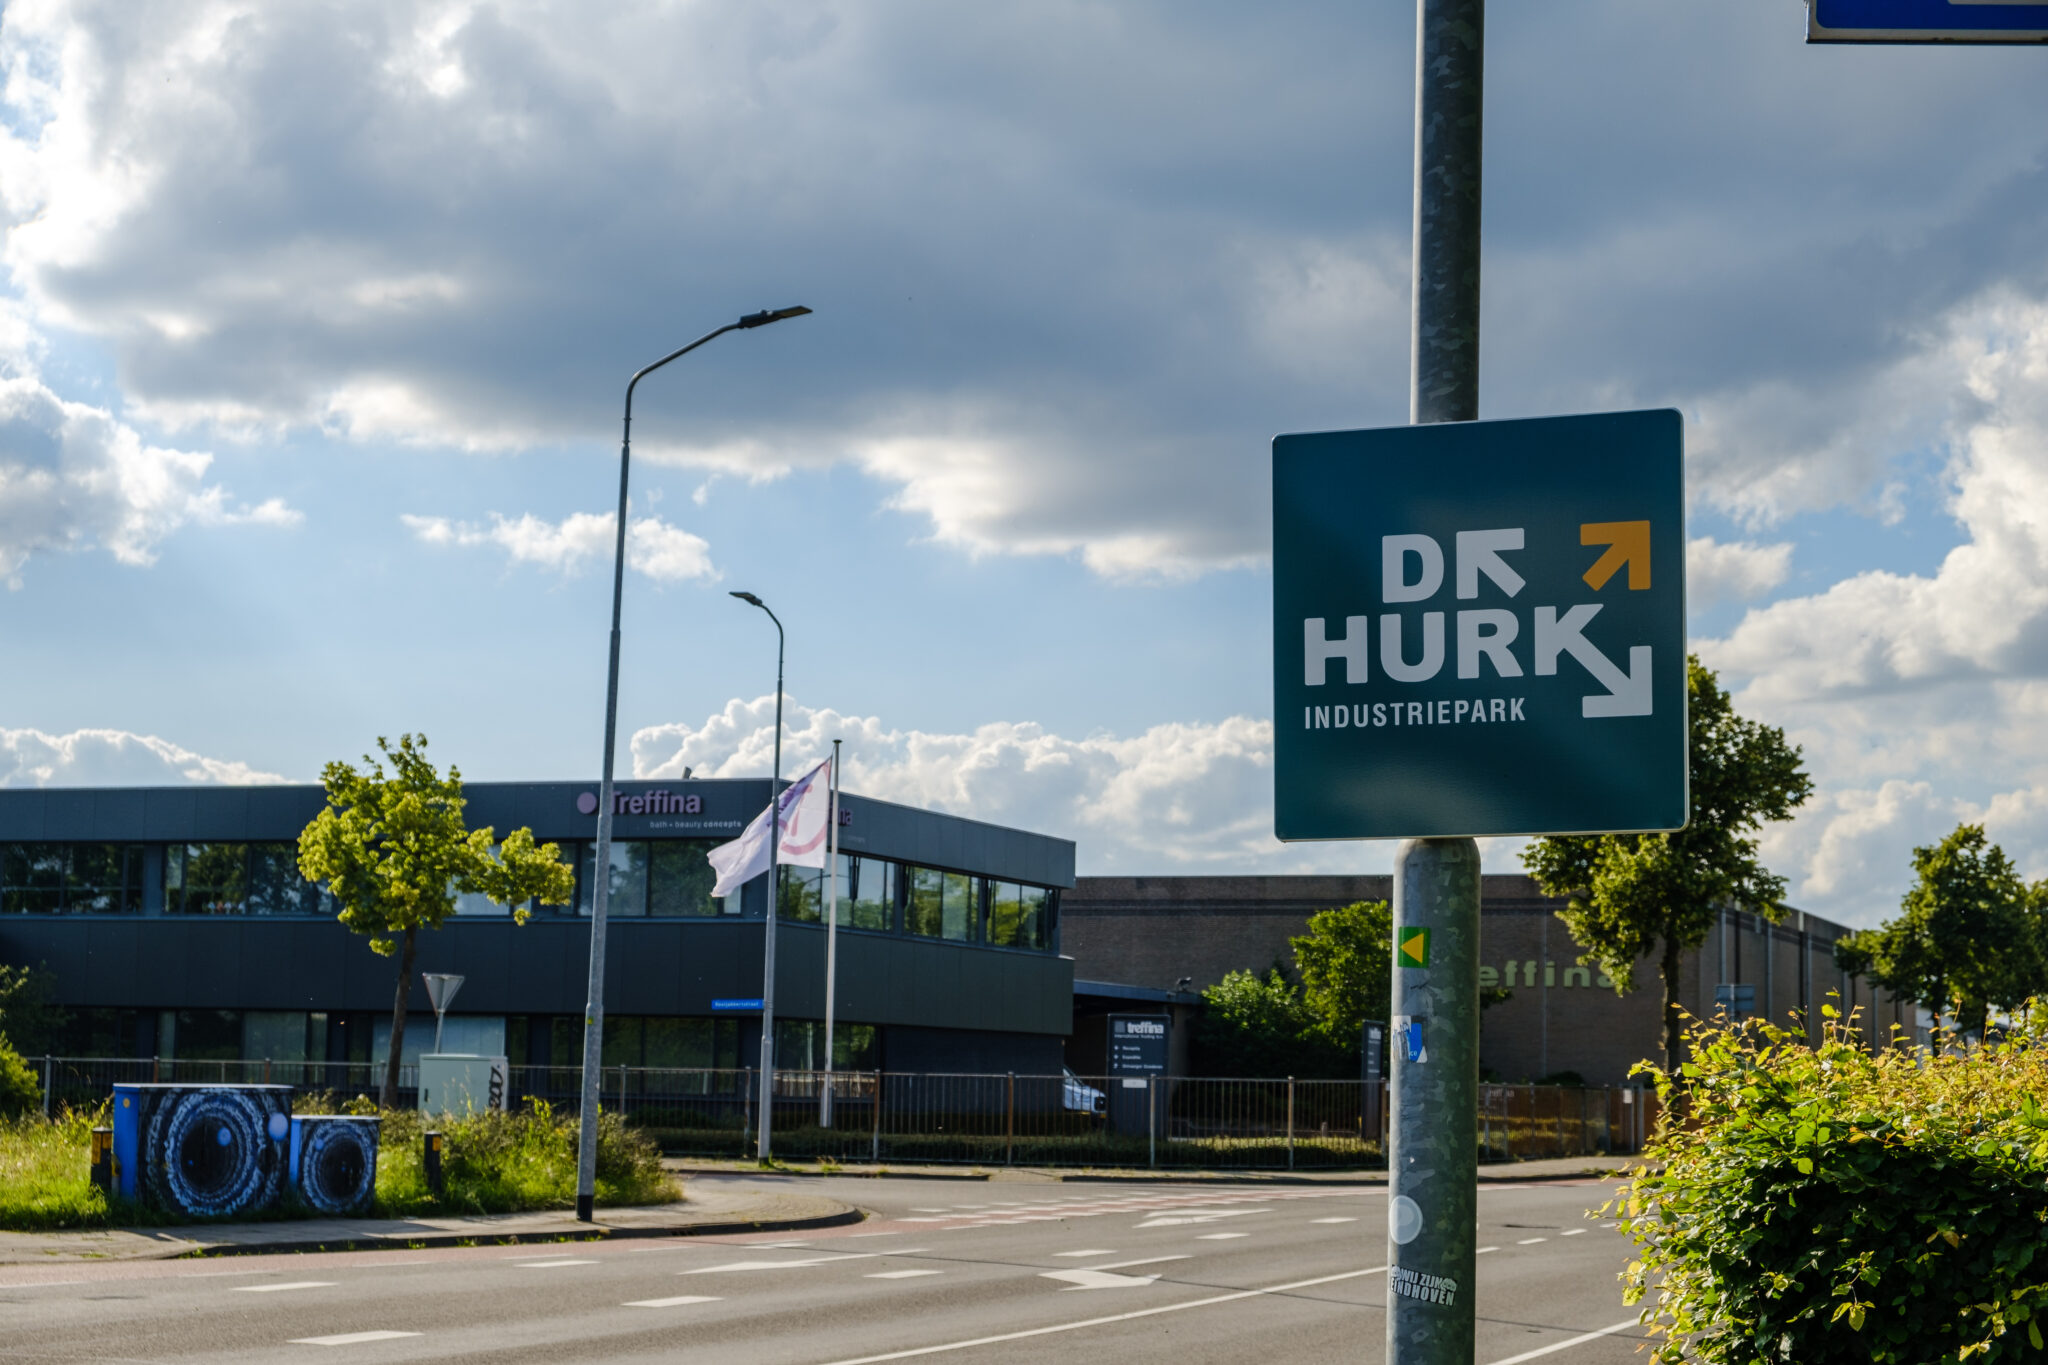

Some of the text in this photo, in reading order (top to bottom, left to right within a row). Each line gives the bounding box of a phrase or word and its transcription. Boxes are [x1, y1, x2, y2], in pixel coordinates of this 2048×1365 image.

[1304, 603, 1652, 718] HURK
[1304, 697, 1526, 730] INDUSTRIEPARK
[703, 820, 742, 830] concepts
[1127, 1021, 1164, 1034] treffina
[1400, 1268, 1443, 1289] WIJ ZIJN
[1391, 1277, 1455, 1306] EINDHOVEN
